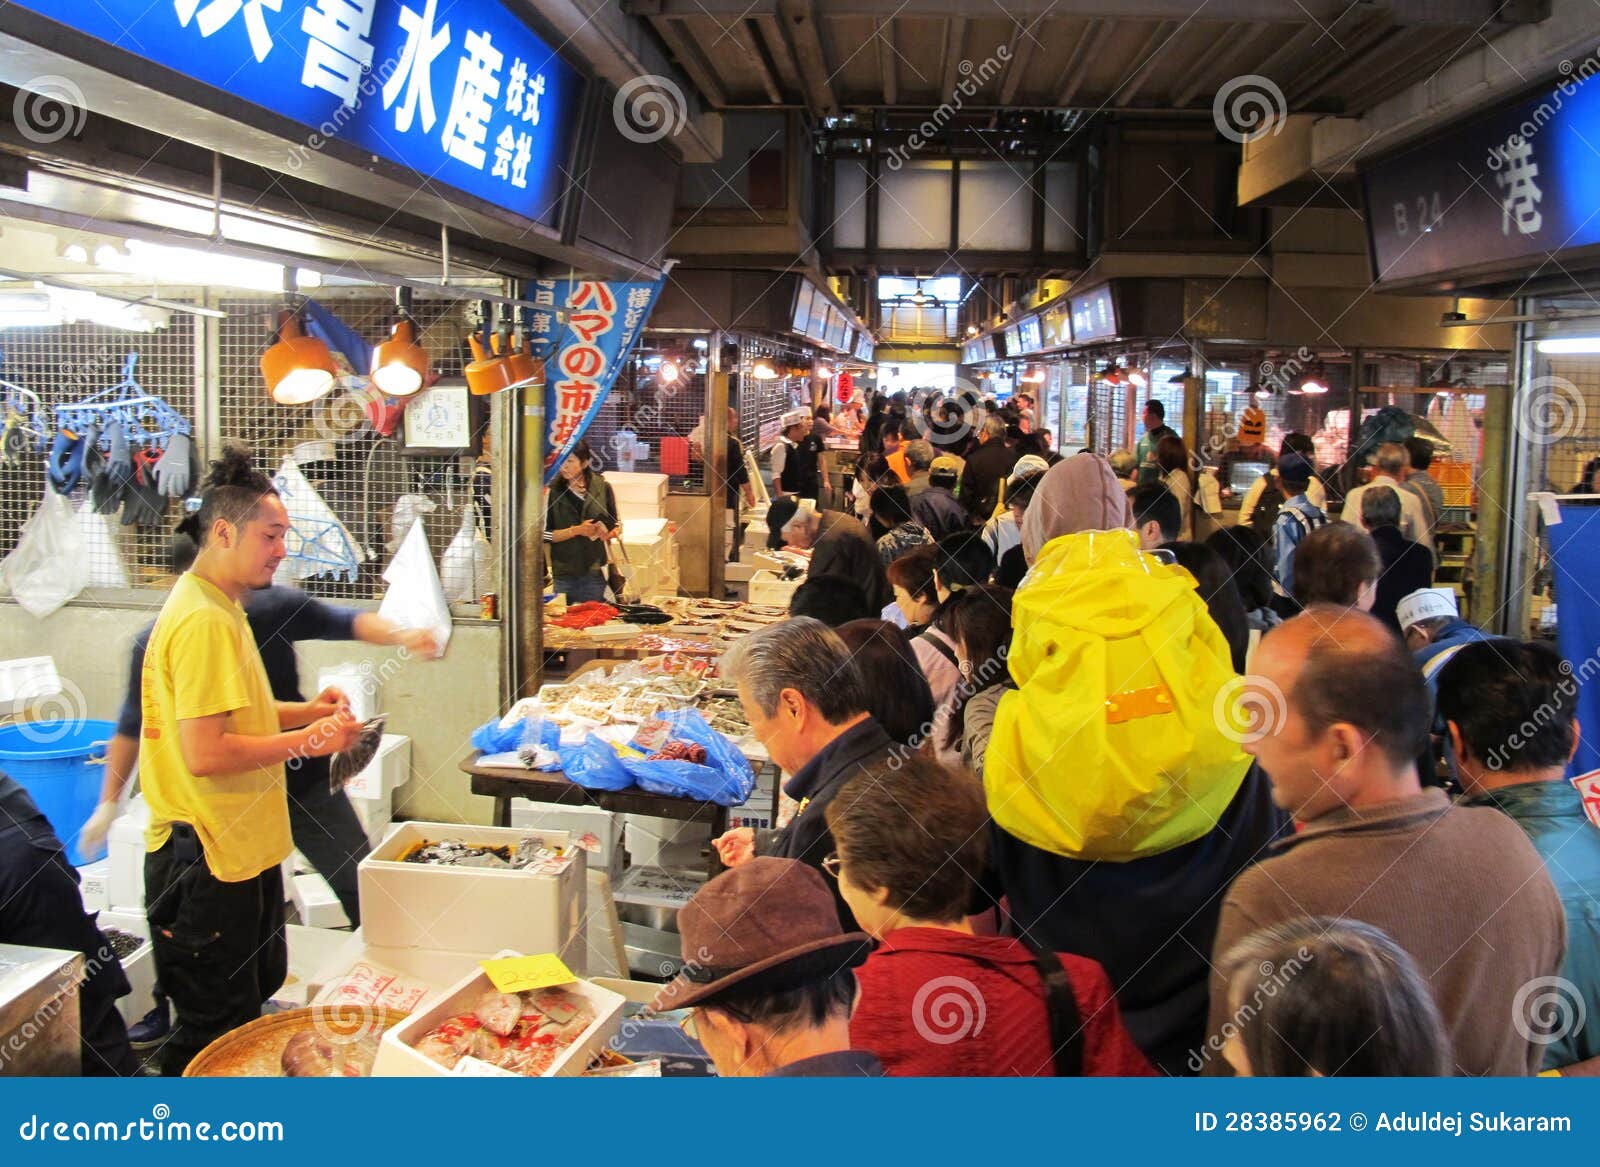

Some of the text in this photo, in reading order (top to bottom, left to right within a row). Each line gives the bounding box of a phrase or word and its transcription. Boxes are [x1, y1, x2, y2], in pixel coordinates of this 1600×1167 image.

[506, 57, 546, 127] 株式
[494, 124, 533, 189] 会社
[1497, 138, 1544, 236] 港
[546, 281, 618, 466] ハマの市場
